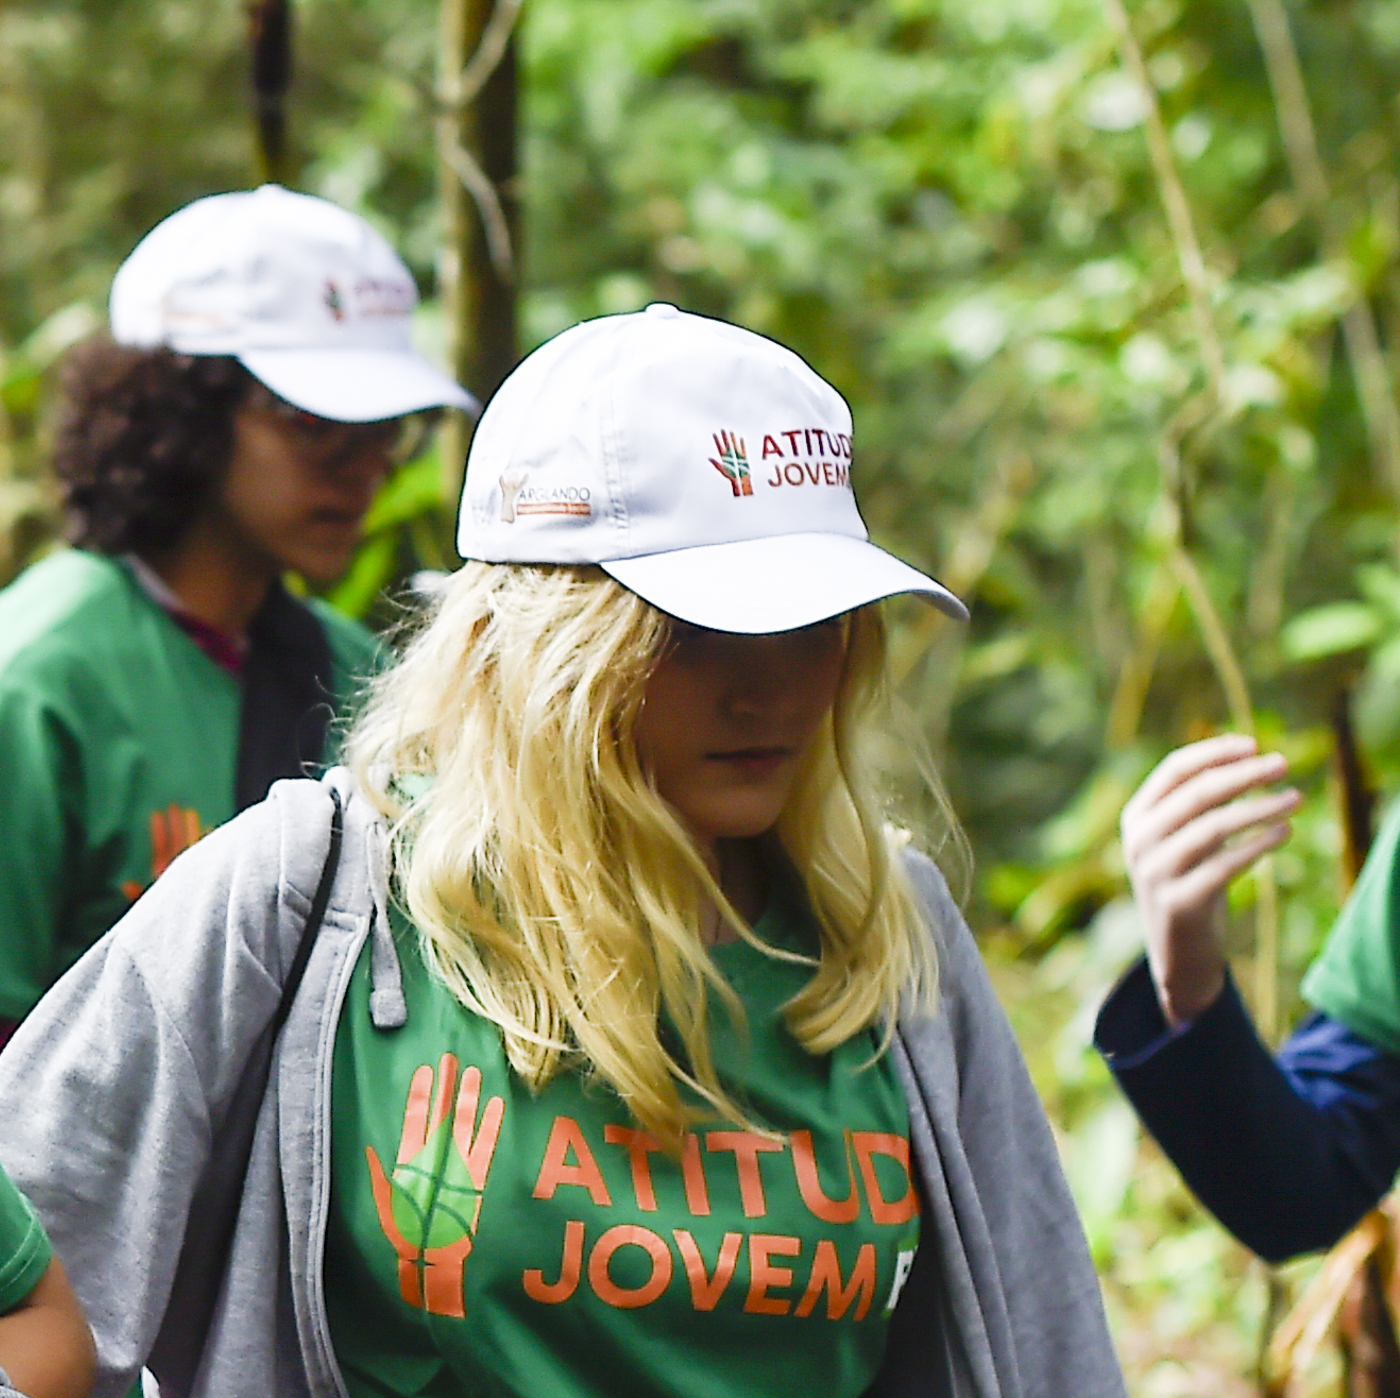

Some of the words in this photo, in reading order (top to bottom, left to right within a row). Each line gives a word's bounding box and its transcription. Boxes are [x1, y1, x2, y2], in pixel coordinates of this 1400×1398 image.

[762, 429, 852, 460] ATITUD
[519, 486, 590, 501] ARGANDO
[532, 1115, 921, 1225] ATITUD
[522, 1221, 877, 1322] JOVEM
